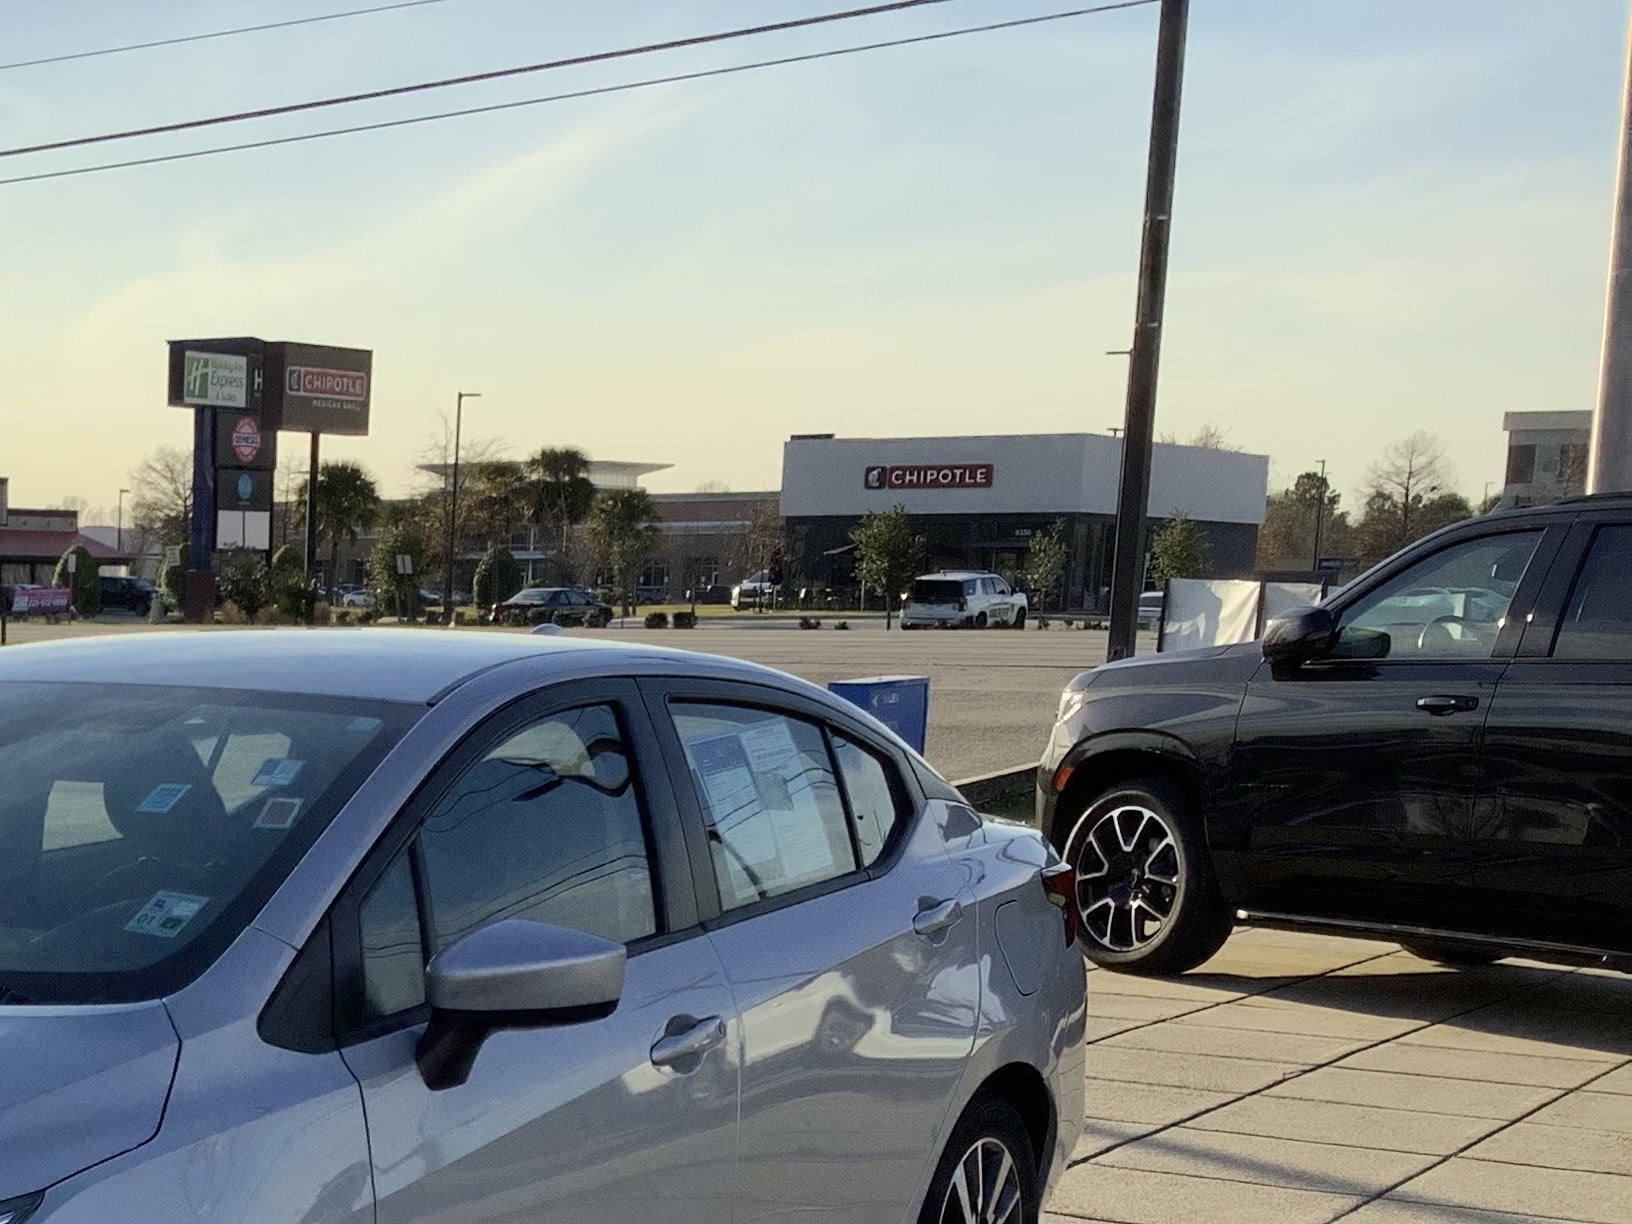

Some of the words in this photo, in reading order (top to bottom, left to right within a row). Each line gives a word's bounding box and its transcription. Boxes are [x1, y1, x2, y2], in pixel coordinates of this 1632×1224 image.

[210, 370, 244, 390] Express
[304, 374, 363, 395] CHIPOTLE
[891, 467, 988, 485] CHIPOTLE
